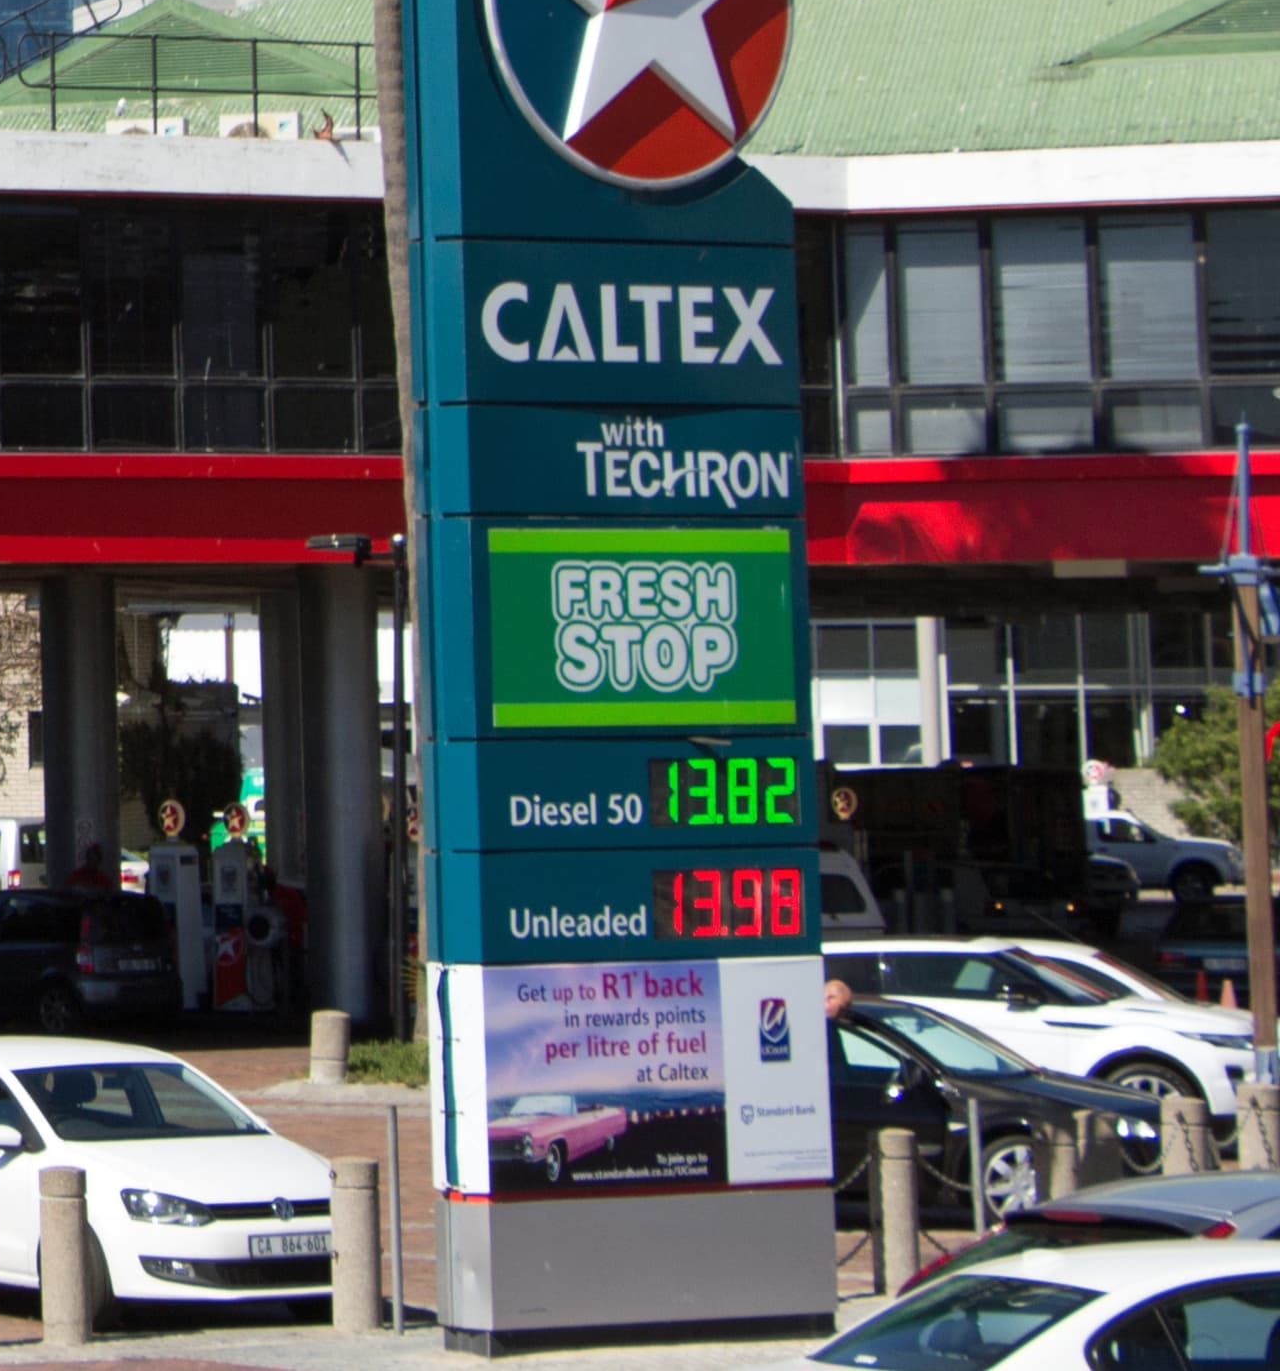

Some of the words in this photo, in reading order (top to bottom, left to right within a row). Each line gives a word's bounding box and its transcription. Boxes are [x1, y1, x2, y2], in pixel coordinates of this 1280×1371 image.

[480, 280, 783, 366] CALTEX
[600, 415, 664, 448] with
[575, 441, 791, 509] TECHRON
[553, 562, 737, 623] FRESH
[556, 623, 738, 692] STOP
[509, 794, 597, 826] Diesel
[607, 793, 643, 826] 50
[668, 757, 795, 825] 13.82
[509, 904, 648, 939] Unleaded
[672, 868, 801, 938] 13.98
[517, 983, 547, 1003] Get
[552, 986, 574, 1005] up
[579, 983, 596, 1001] to
[644, 969, 704, 999] back
[564, 1009, 580, 1028] in
[585, 1007, 650, 1028] rewards
[655, 1006, 706, 1027] points
[545, 1041, 580, 1065] per
[586, 1035, 631, 1058] litre
[637, 1032, 659, 1056] of
[665, 1030, 707, 1054] fuel
[636, 1066, 652, 1083] at
[658, 1062, 709, 1083] Caltex
[756, 1105, 794, 1117] Standard
[795, 1104, 816, 1116] Bank
[257, 1237, 272, 1255] CA
